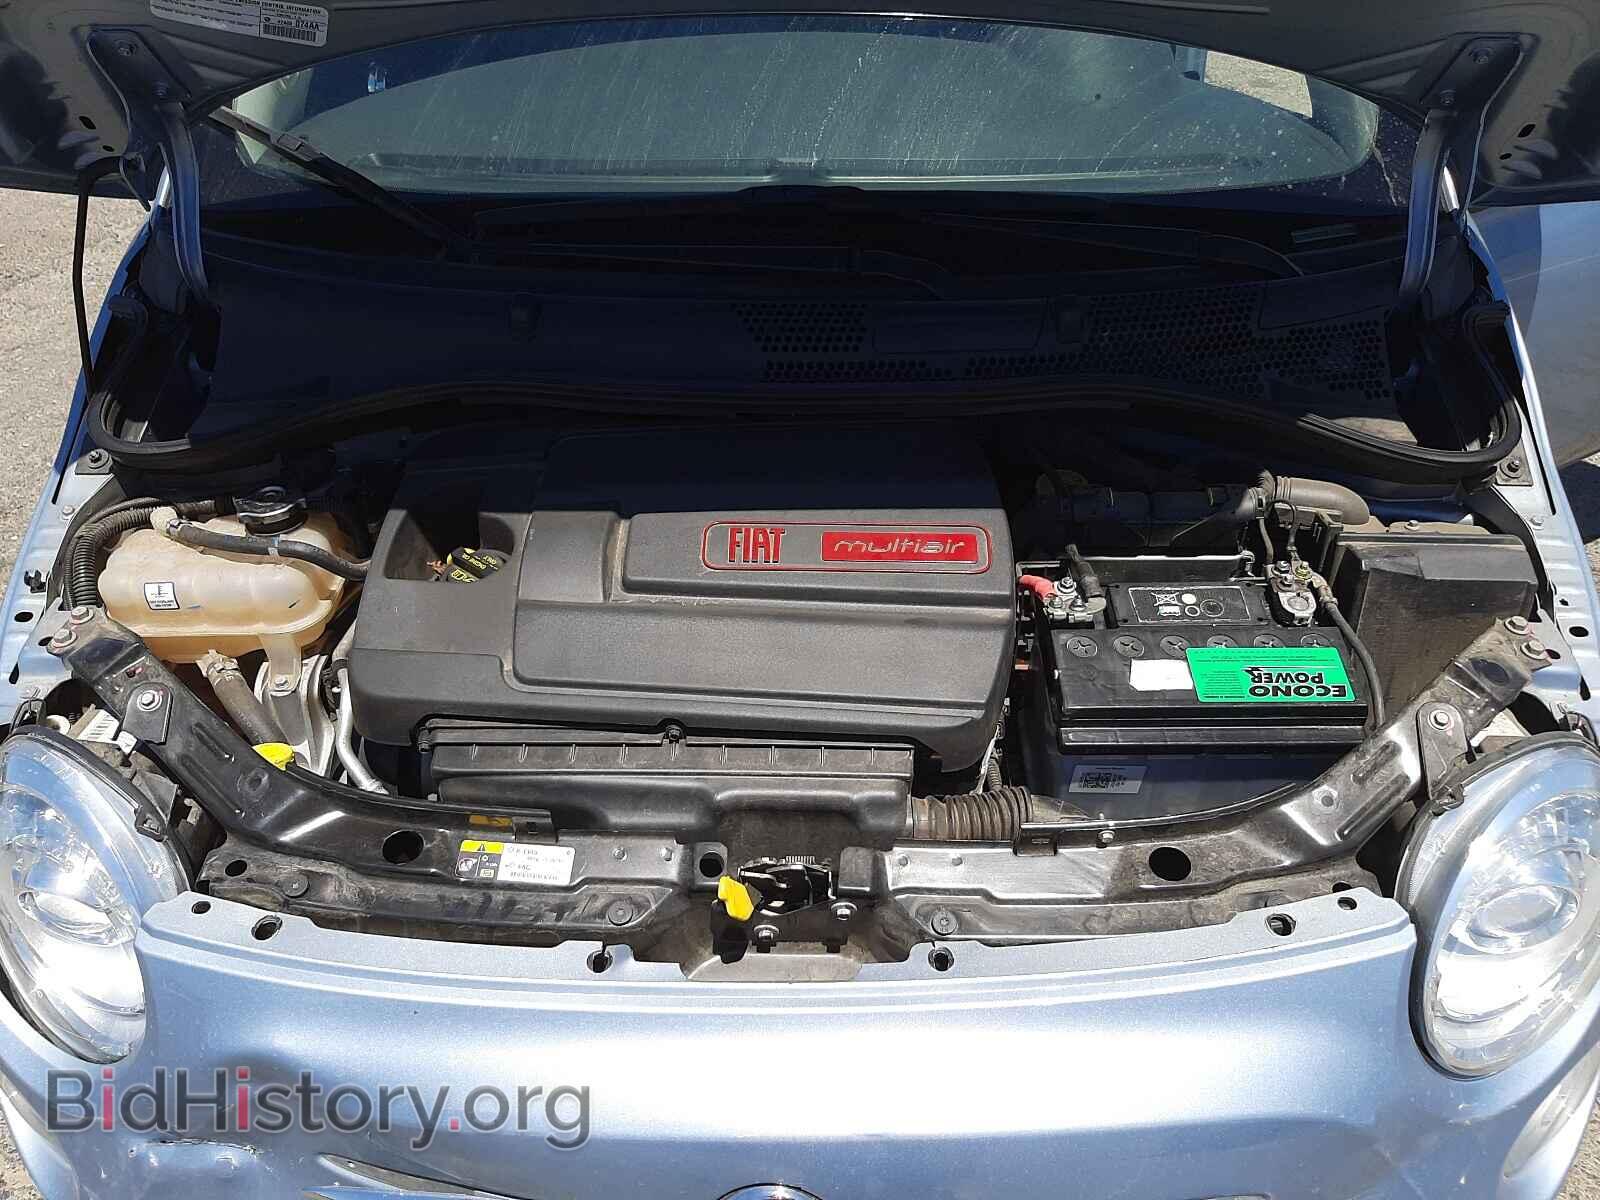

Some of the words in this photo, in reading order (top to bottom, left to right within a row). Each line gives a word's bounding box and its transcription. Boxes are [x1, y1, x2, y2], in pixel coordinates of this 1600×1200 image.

[728, 527, 786, 563] FIAT
[834, 538, 965, 554] multiair
[1248, 669, 1324, 684] POWER
[1248, 685, 1347, 698] ECONO
